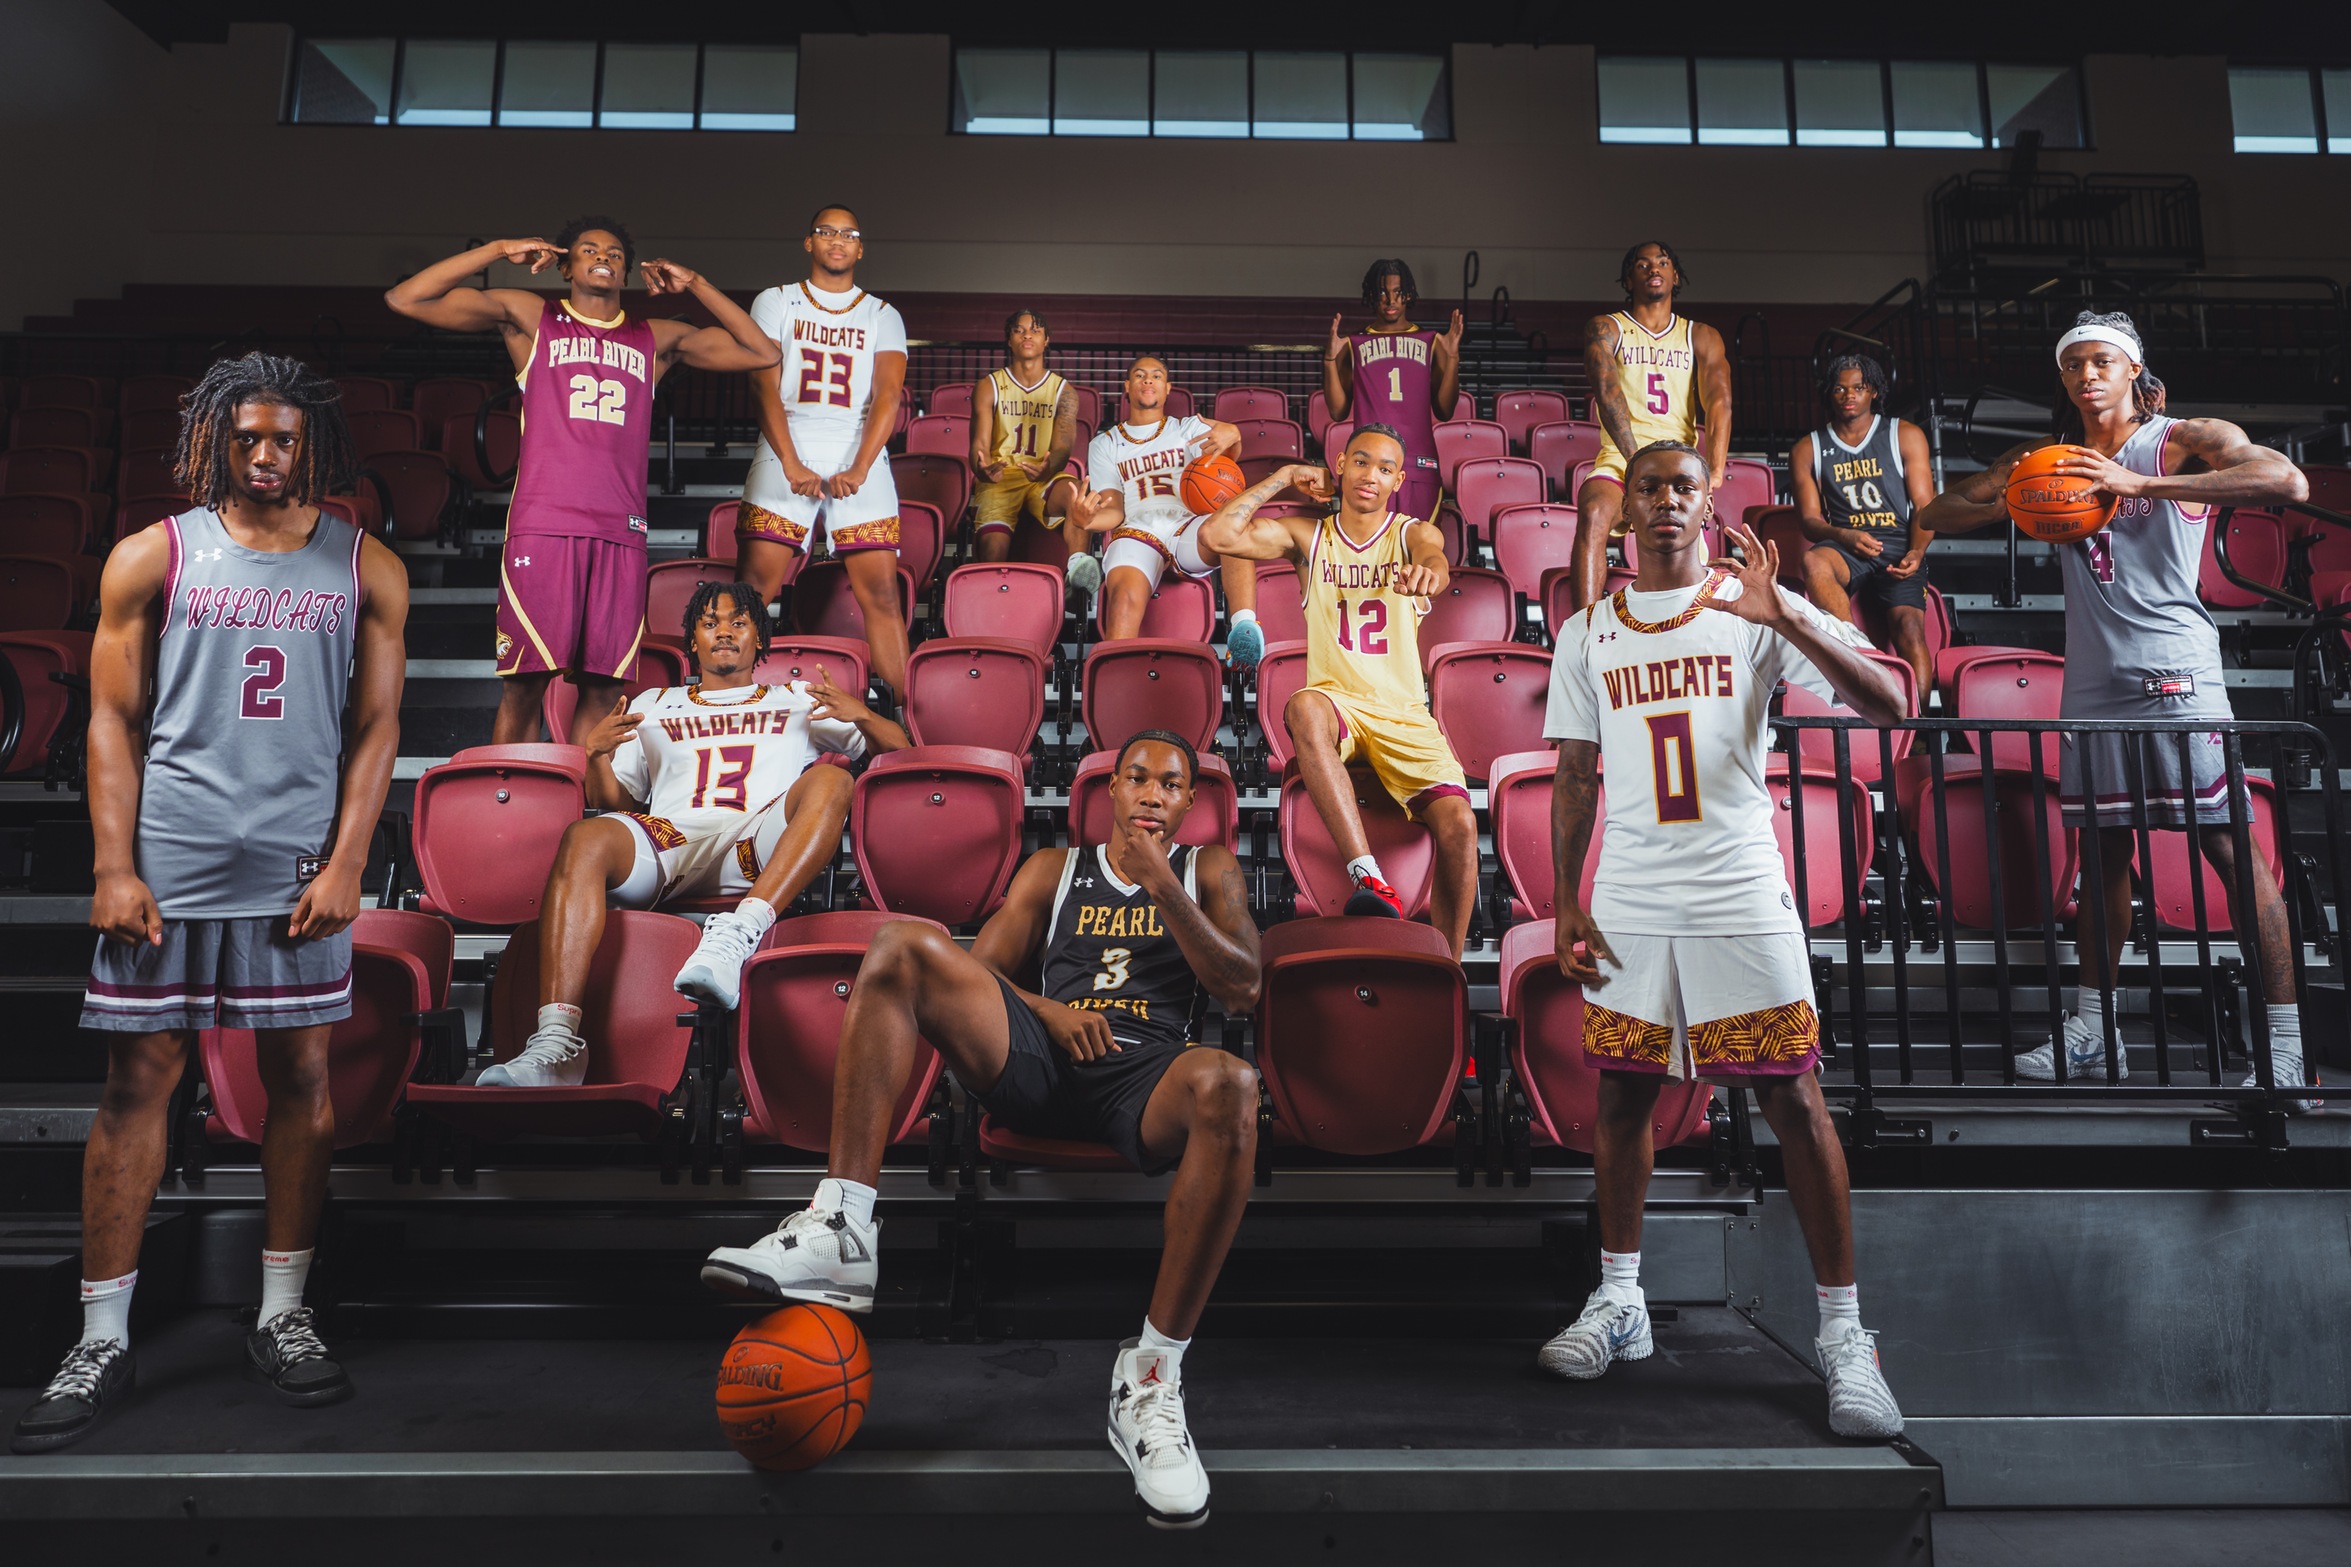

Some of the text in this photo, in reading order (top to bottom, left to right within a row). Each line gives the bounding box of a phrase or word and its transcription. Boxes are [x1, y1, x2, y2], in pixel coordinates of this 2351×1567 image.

[793, 319, 865, 350] WILDCATS
[1358, 336, 1427, 367] PEARL RIVER
[548, 337, 646, 383] PEARL RIVER
[1621, 346, 1690, 370] WILDCATS
[798, 348, 854, 409] 23
[1388, 367, 1403, 401] 1
[1646, 372, 1669, 415] 5
[569, 374, 626, 426] 22
[1001, 400, 1053, 418] WILDCATS
[1011, 422, 1037, 458] 11
[1117, 447, 1185, 482] WILDCATS
[1833, 457, 1883, 482] PEARL
[1134, 473, 1177, 501] 15
[1842, 481, 1883, 510] 10
[1321, 559, 1400, 589] WILDCATS
[2089, 531, 2114, 583] 4
[186, 585, 347, 635] WILDCATS
[1336, 598, 1389, 655] 12
[239, 644, 287, 720] 2
[1602, 655, 1734, 711] WILDCATS
[659, 708, 791, 742] WILDCATS
[690, 744, 756, 812] 13
[1643, 709, 1703, 825] 0
[1075, 905, 1164, 937] PEARL
[1093, 947, 1133, 991] 3
